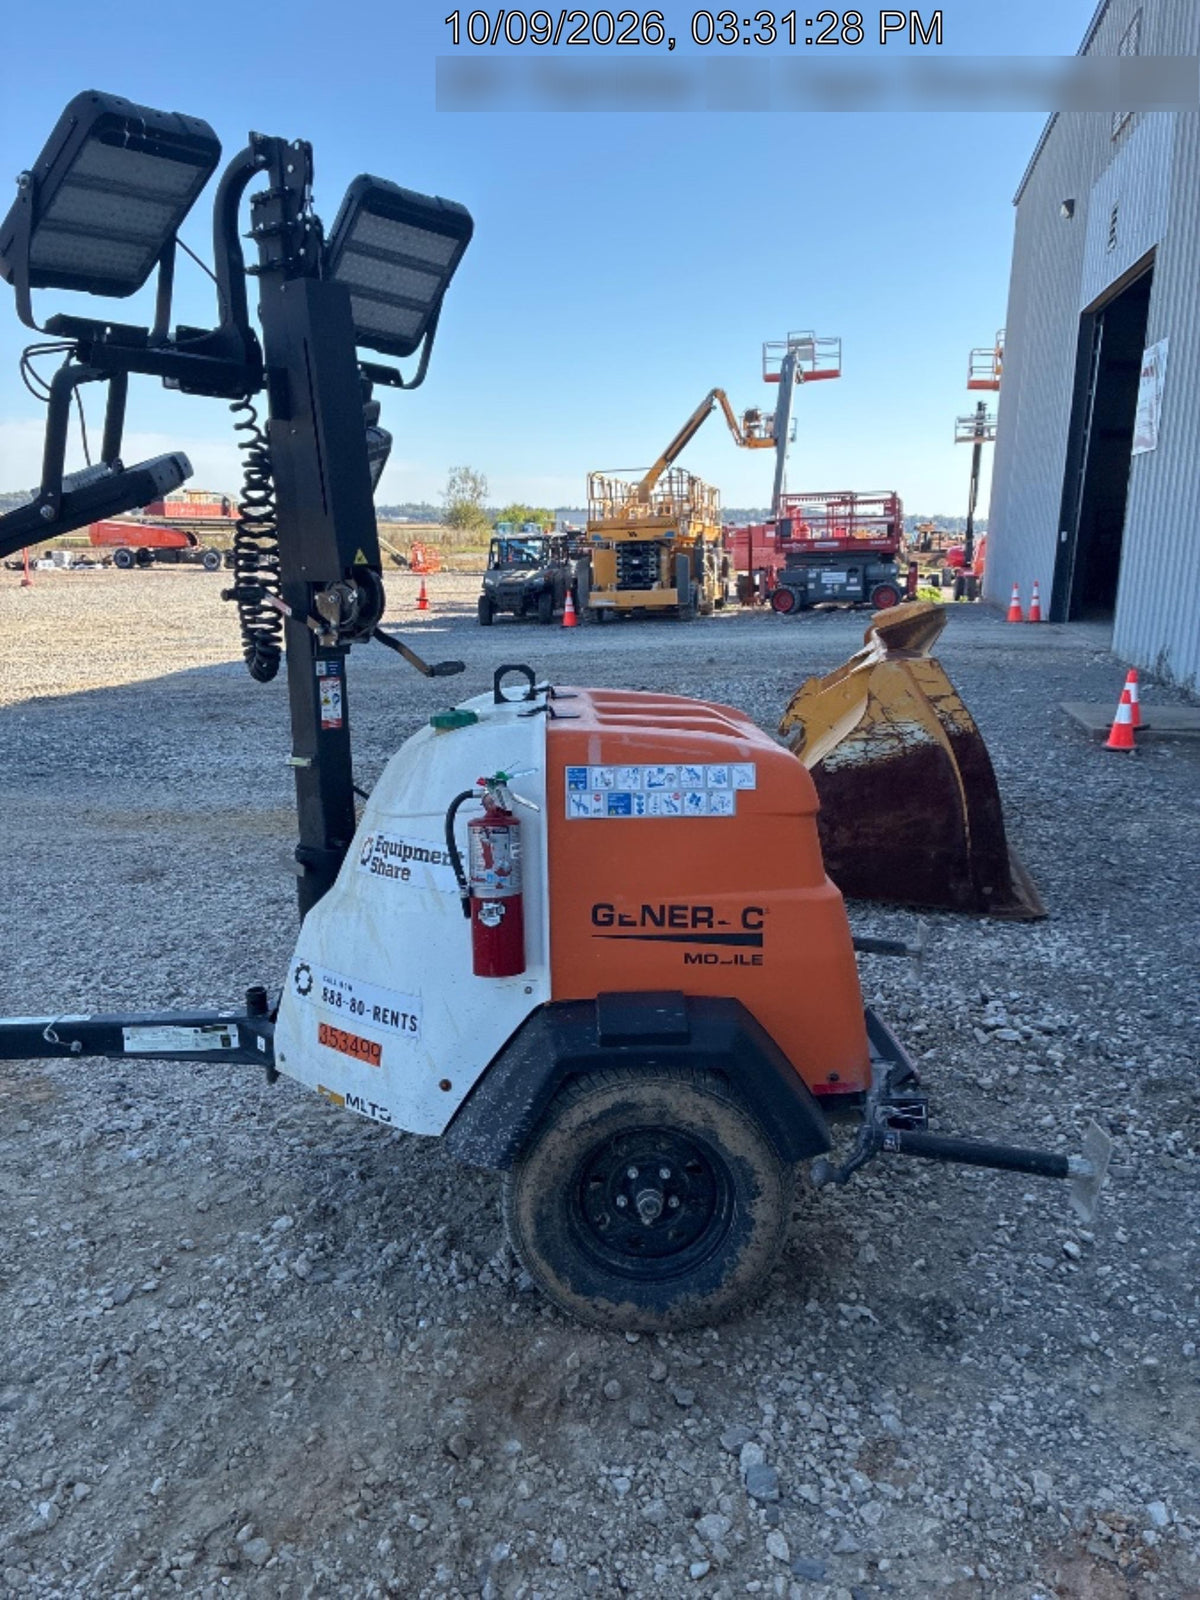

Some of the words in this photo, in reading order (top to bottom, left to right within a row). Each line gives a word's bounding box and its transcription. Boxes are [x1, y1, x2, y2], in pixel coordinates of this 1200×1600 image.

[370, 856, 411, 881] Share
[591, 903, 764, 930] GENERC
[684, 952, 764, 966] MOILE
[319, 1023, 382, 1066] 353499
